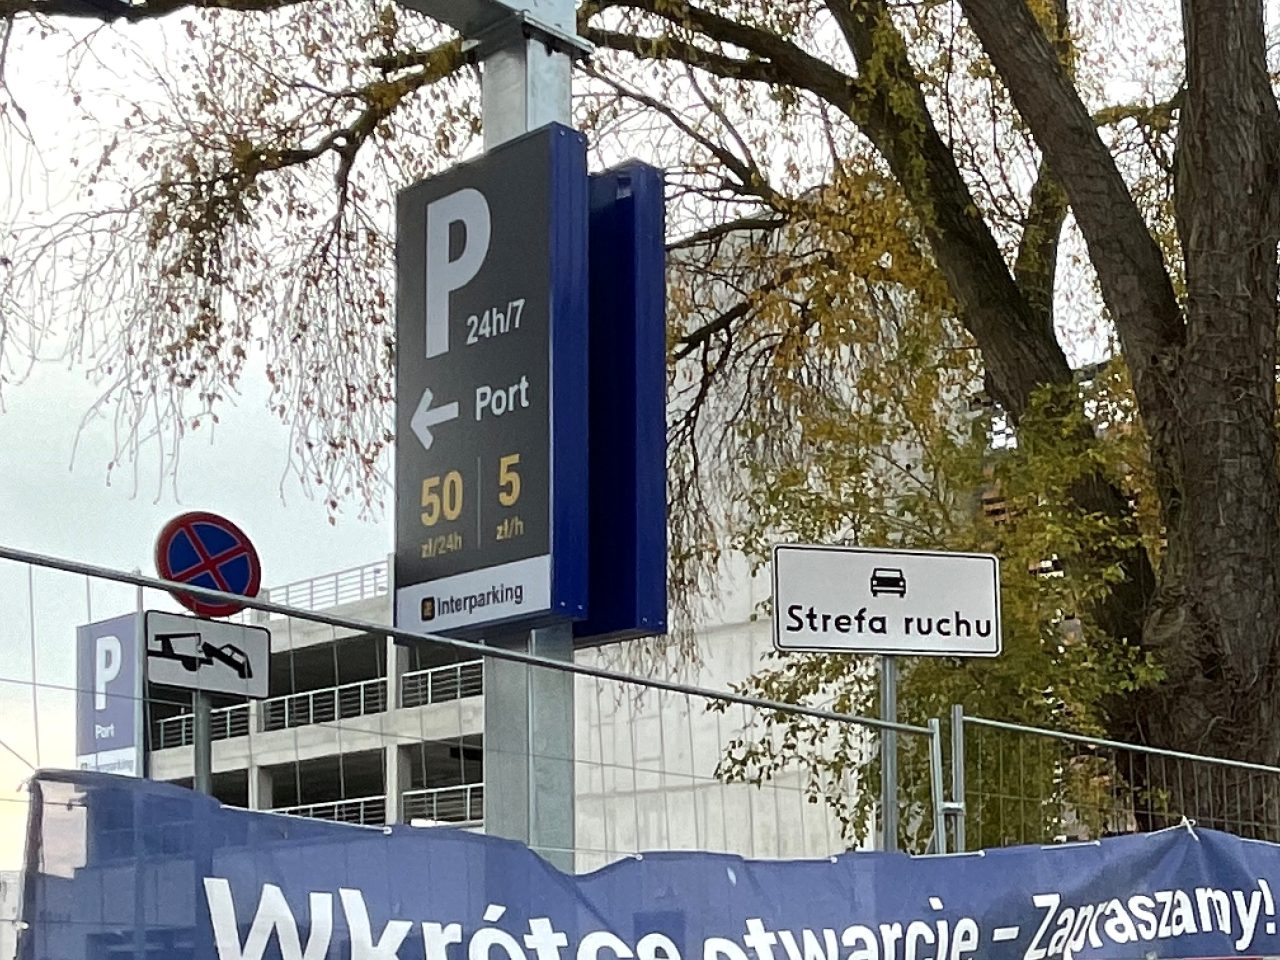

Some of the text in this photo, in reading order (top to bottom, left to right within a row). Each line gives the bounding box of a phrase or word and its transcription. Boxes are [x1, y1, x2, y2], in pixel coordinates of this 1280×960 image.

[426, 187, 492, 359] P
[466, 298, 526, 346] 24h/7
[474, 375, 530, 421] Port
[420, 453, 522, 527] 50 5
[437, 584, 523, 616] Interparking
[786, 604, 992, 638] Strefa ruchu
[95, 635, 122, 711] P
